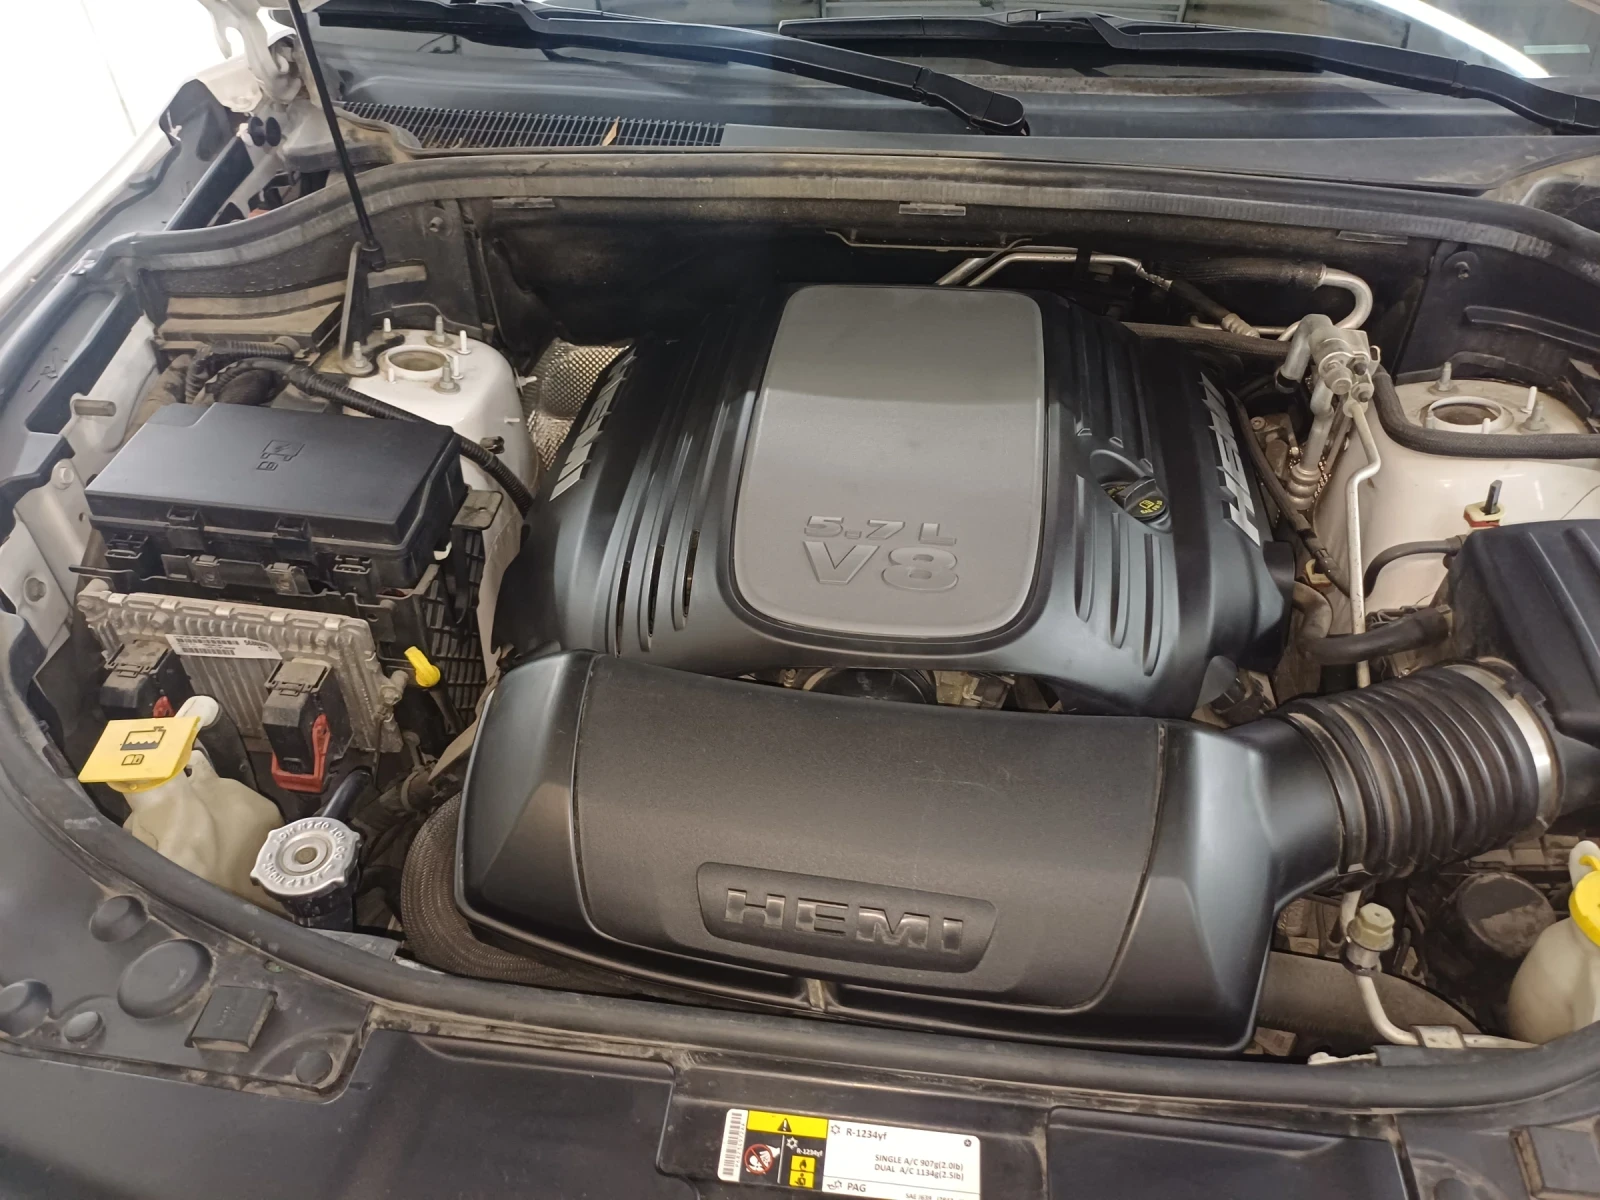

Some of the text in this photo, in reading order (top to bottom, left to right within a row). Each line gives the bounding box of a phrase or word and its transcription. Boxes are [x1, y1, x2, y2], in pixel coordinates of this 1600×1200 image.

[802, 540, 959, 593] V8
[298, 821, 330, 831] OPEN
[724, 888, 963, 953] HEMI
[846, 1127, 887, 1141] R-1234yf
[875, 1154, 902, 1164] SINGLE
[903, 1157, 918, 1166] A/C
[874, 1163, 896, 1173] DUAL
[899, 1166, 914, 1175] A/C
[847, 1182, 867, 1193] PAG
